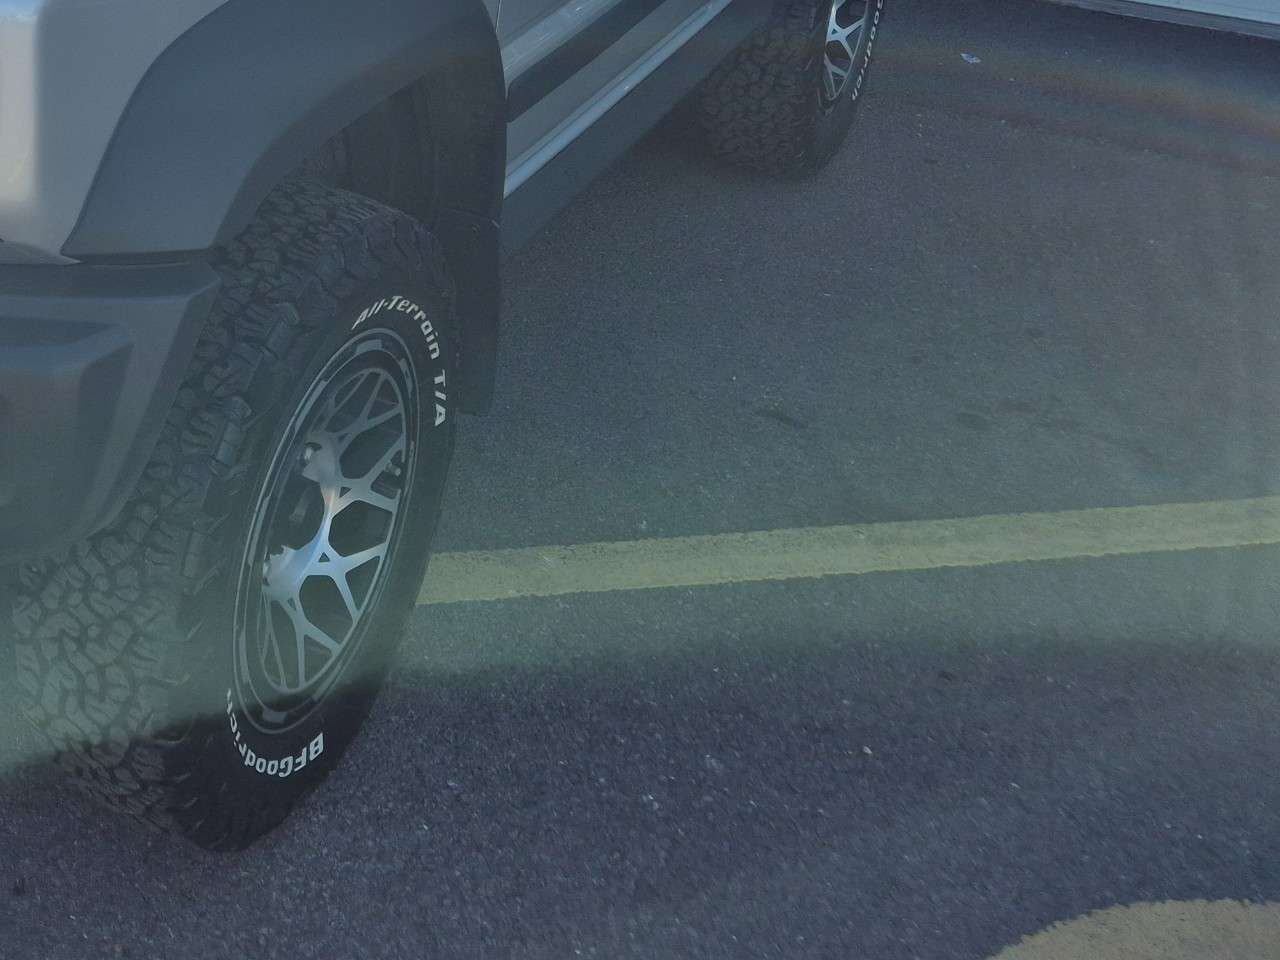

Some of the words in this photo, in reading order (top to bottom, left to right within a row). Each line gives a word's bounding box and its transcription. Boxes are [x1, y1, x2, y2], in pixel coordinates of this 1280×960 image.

[351, 295, 440, 360] All-Terrain
[433, 368, 447, 427] T/A
[226, 688, 323, 777] BFGoodrich
